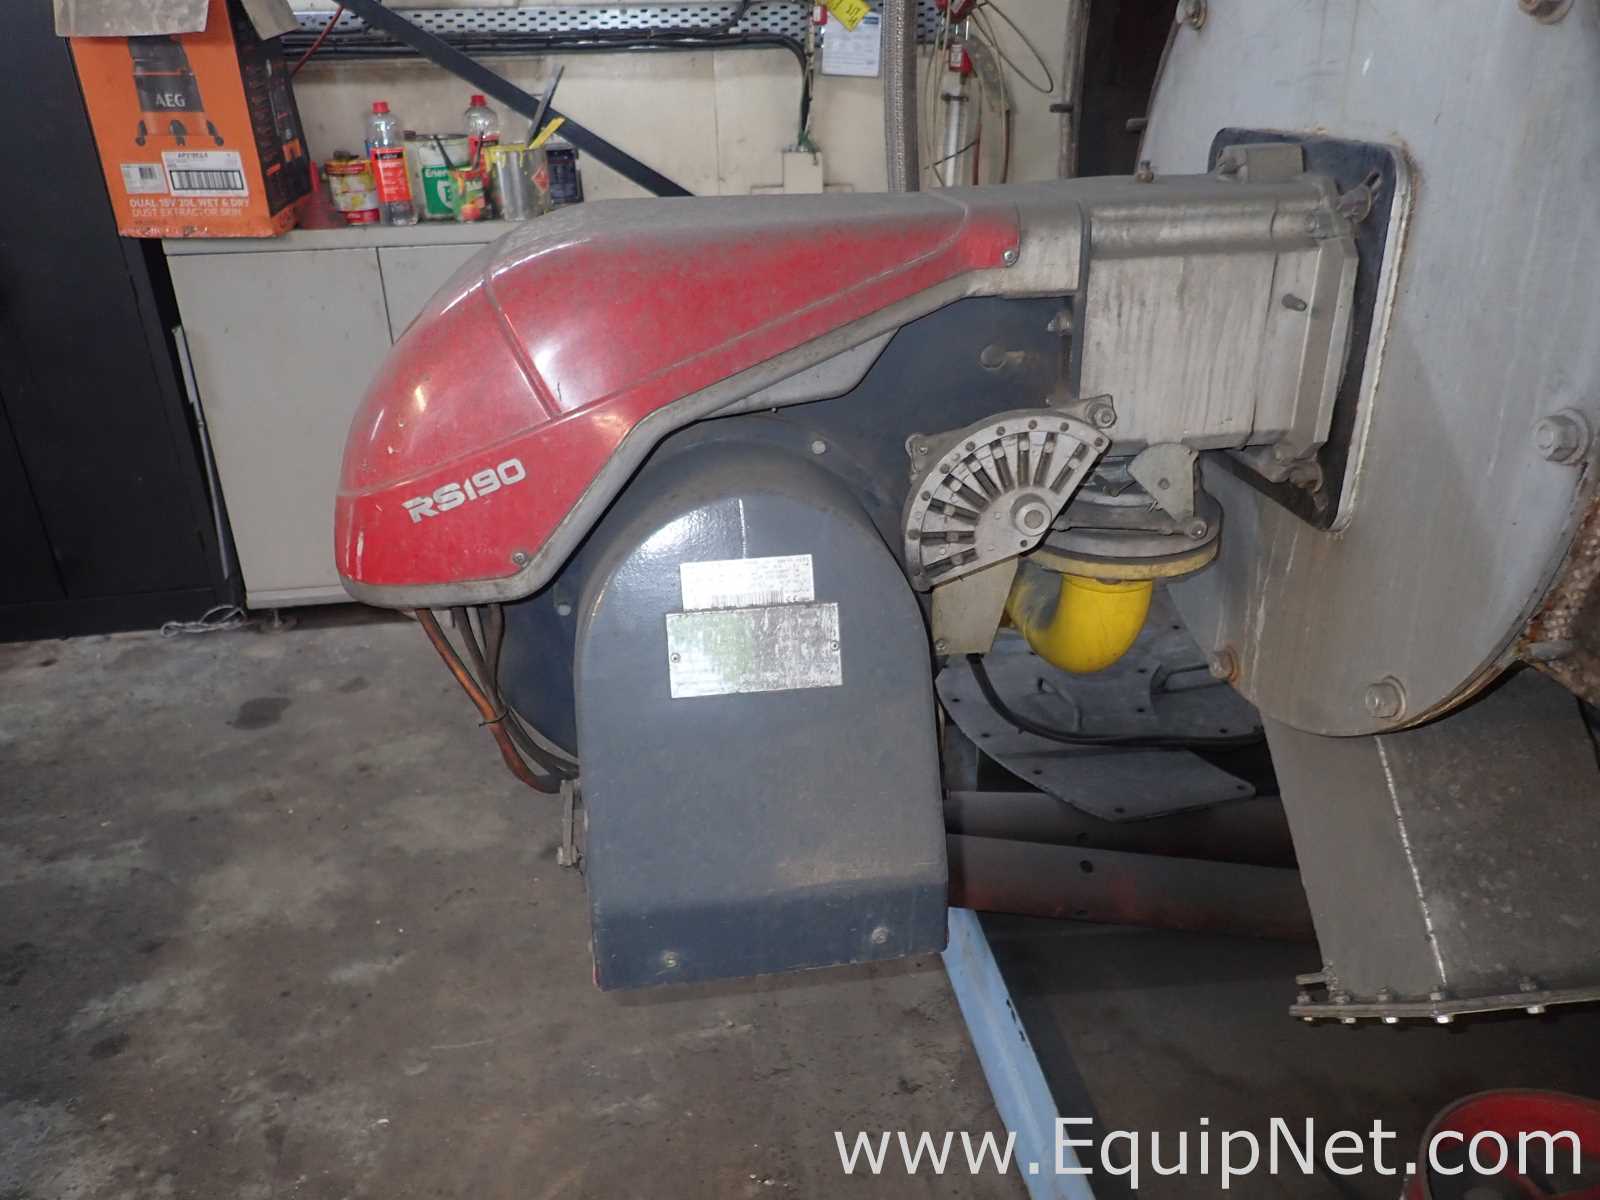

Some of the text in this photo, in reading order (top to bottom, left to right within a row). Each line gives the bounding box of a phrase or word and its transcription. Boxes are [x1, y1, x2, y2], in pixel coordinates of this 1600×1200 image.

[155, 93, 186, 107] AEG
[129, 199, 156, 208] DUAL
[402, 458, 526, 524] RS190
